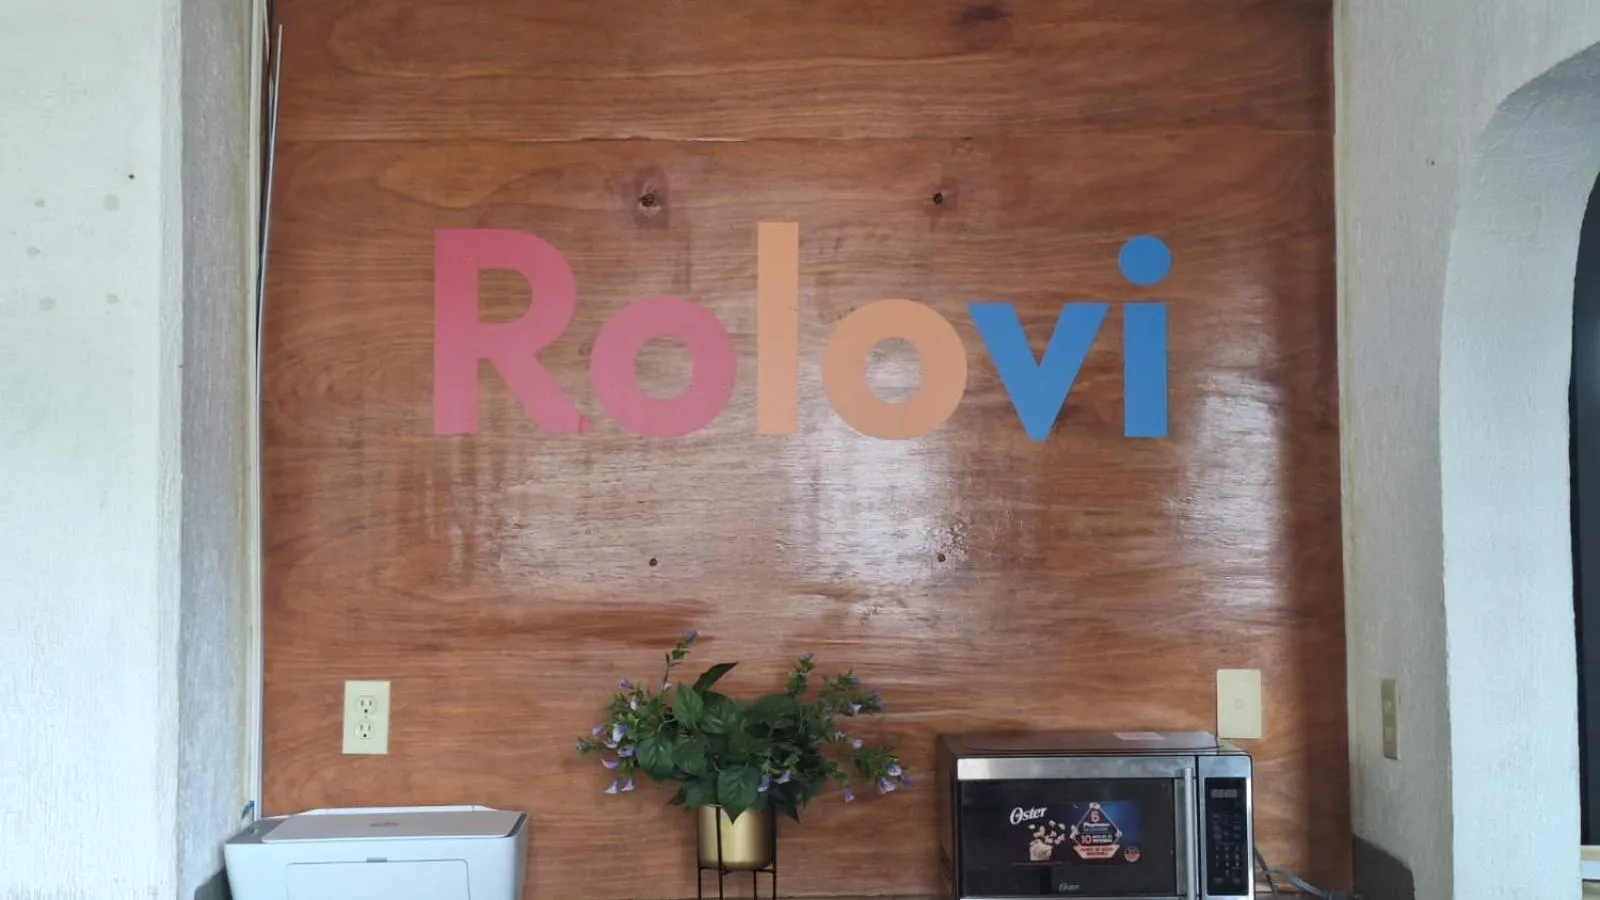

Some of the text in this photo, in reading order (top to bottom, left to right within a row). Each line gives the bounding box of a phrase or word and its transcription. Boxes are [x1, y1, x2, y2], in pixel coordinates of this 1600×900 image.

[433, 222, 1173, 441] Rolovi
[1009, 807, 1048, 825] Oster
[1081, 835, 1092, 845] 10
